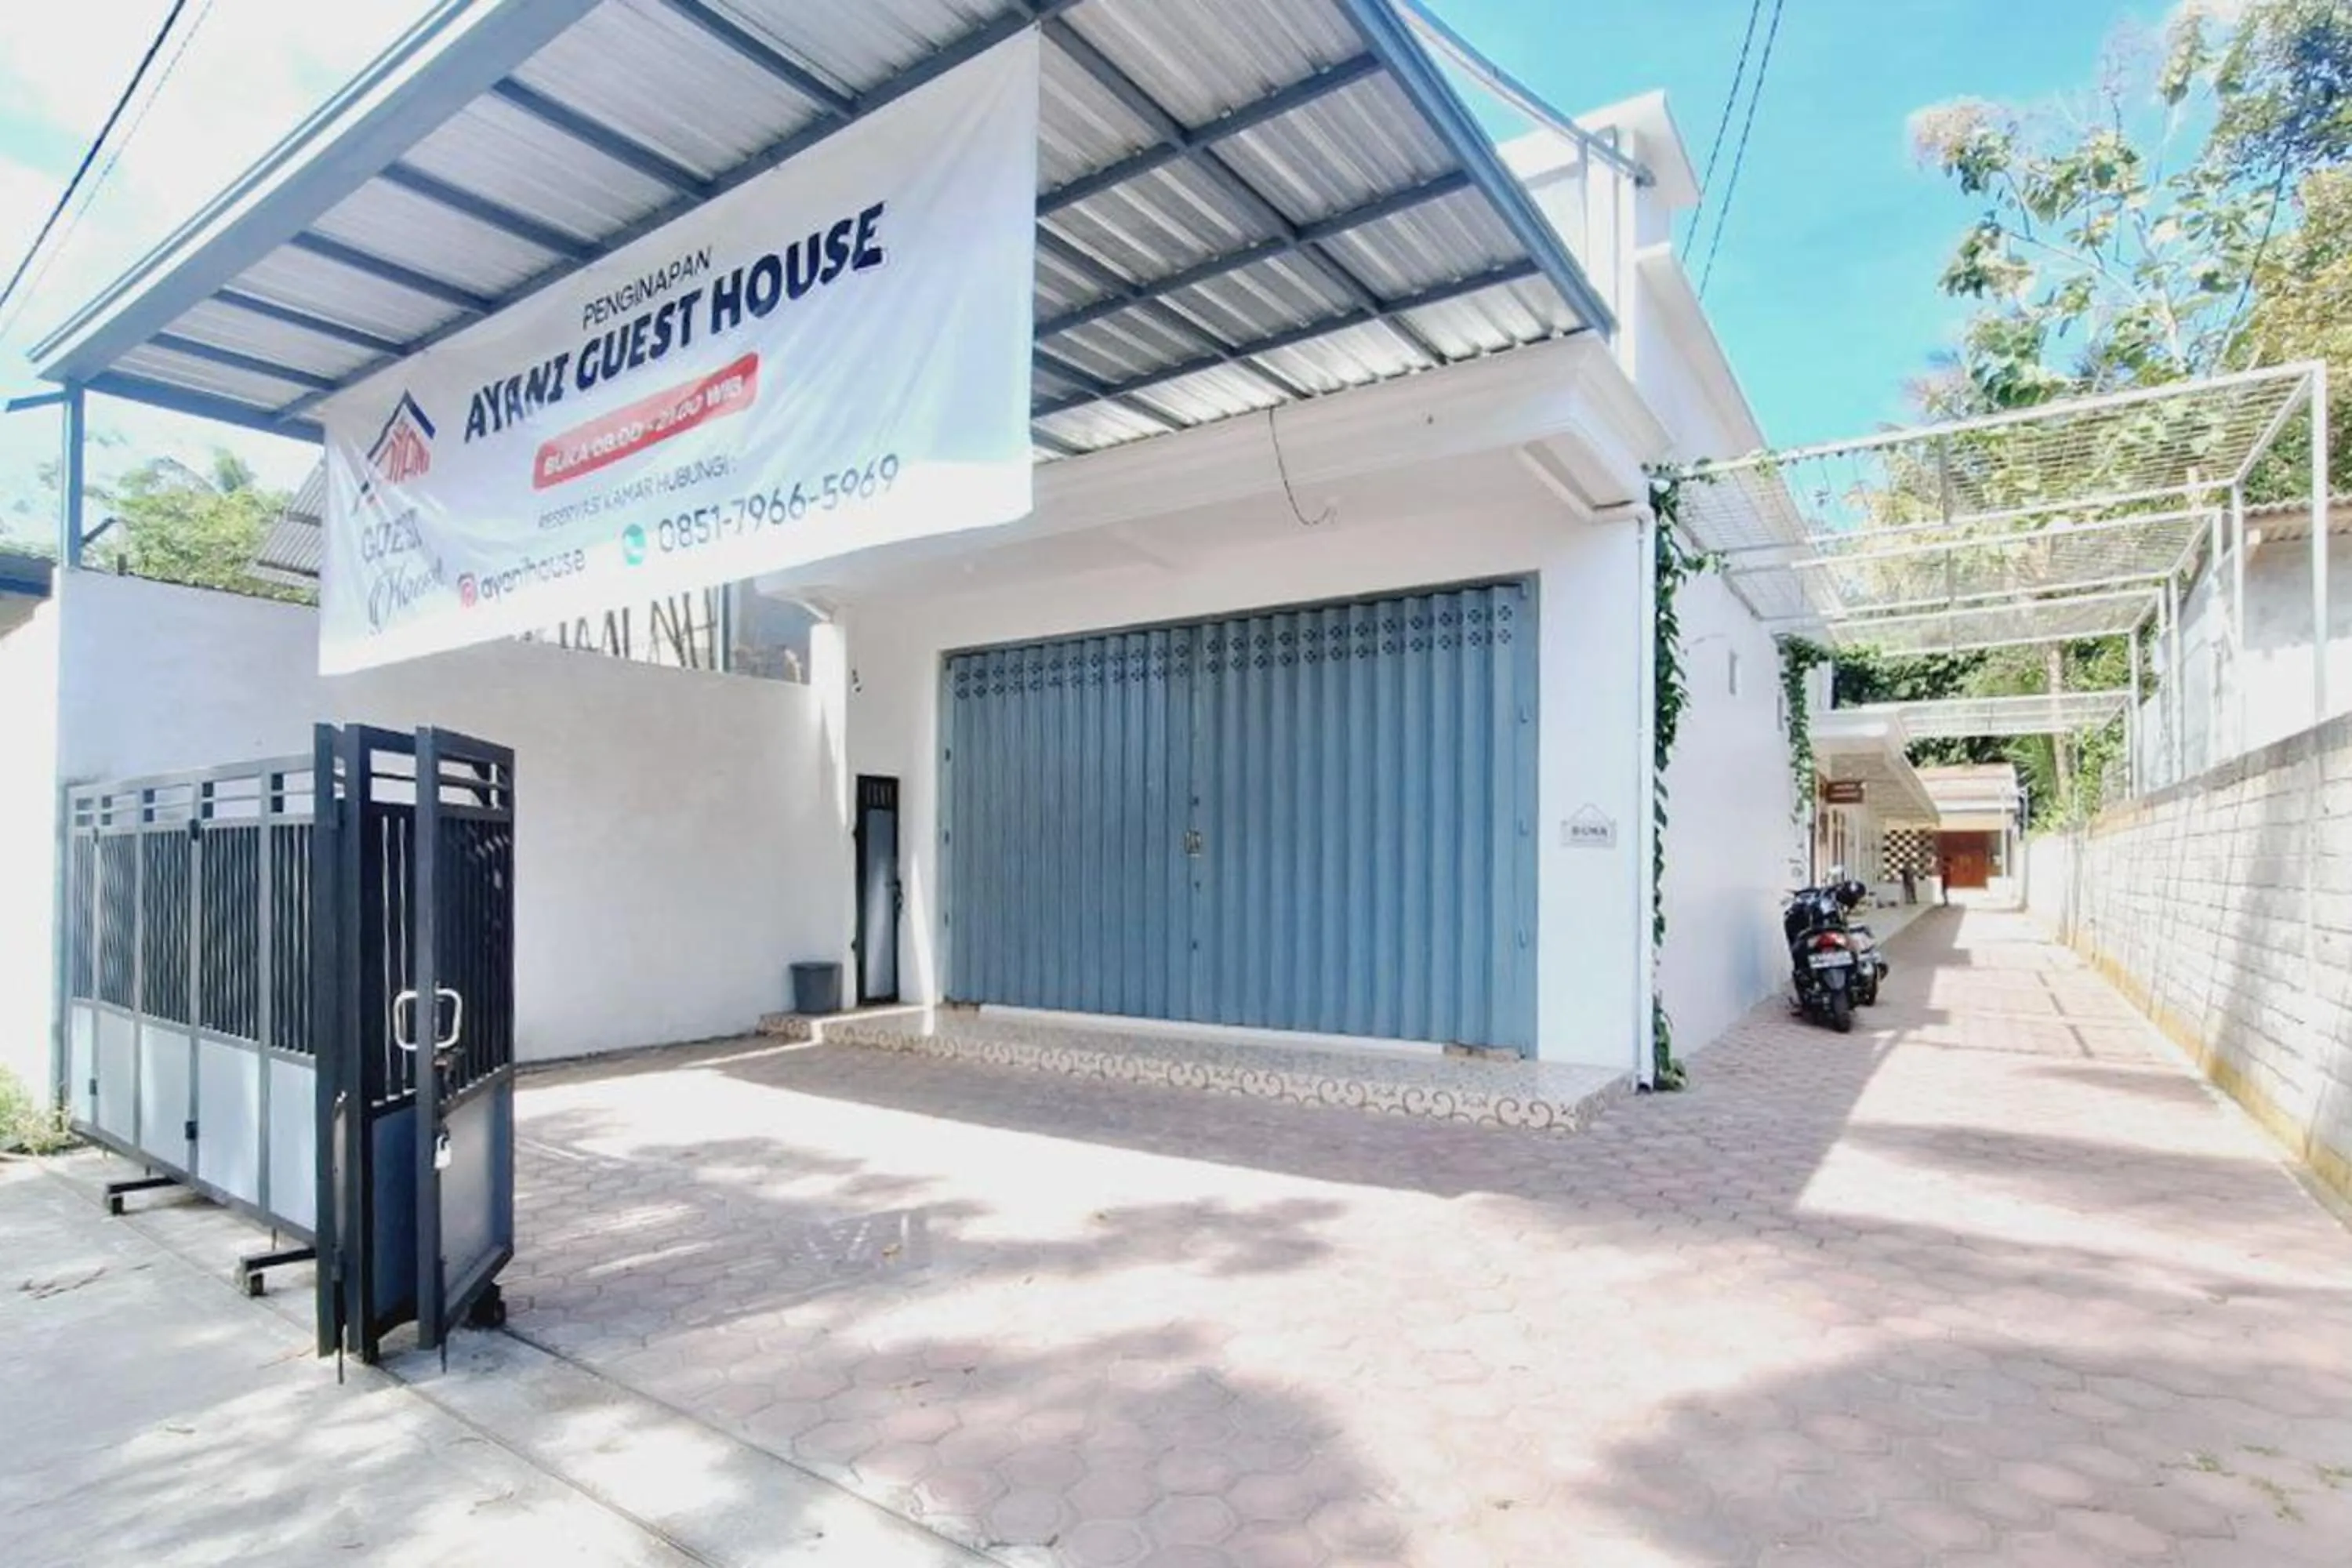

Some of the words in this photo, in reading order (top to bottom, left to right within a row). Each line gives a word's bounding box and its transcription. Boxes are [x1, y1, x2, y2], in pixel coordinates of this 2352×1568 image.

[464, 352, 570, 444] AYANI
[575, 288, 702, 392] GUEST
[710, 201, 886, 335] HOUSE
[583, 245, 712, 330] PENGINAPAN
